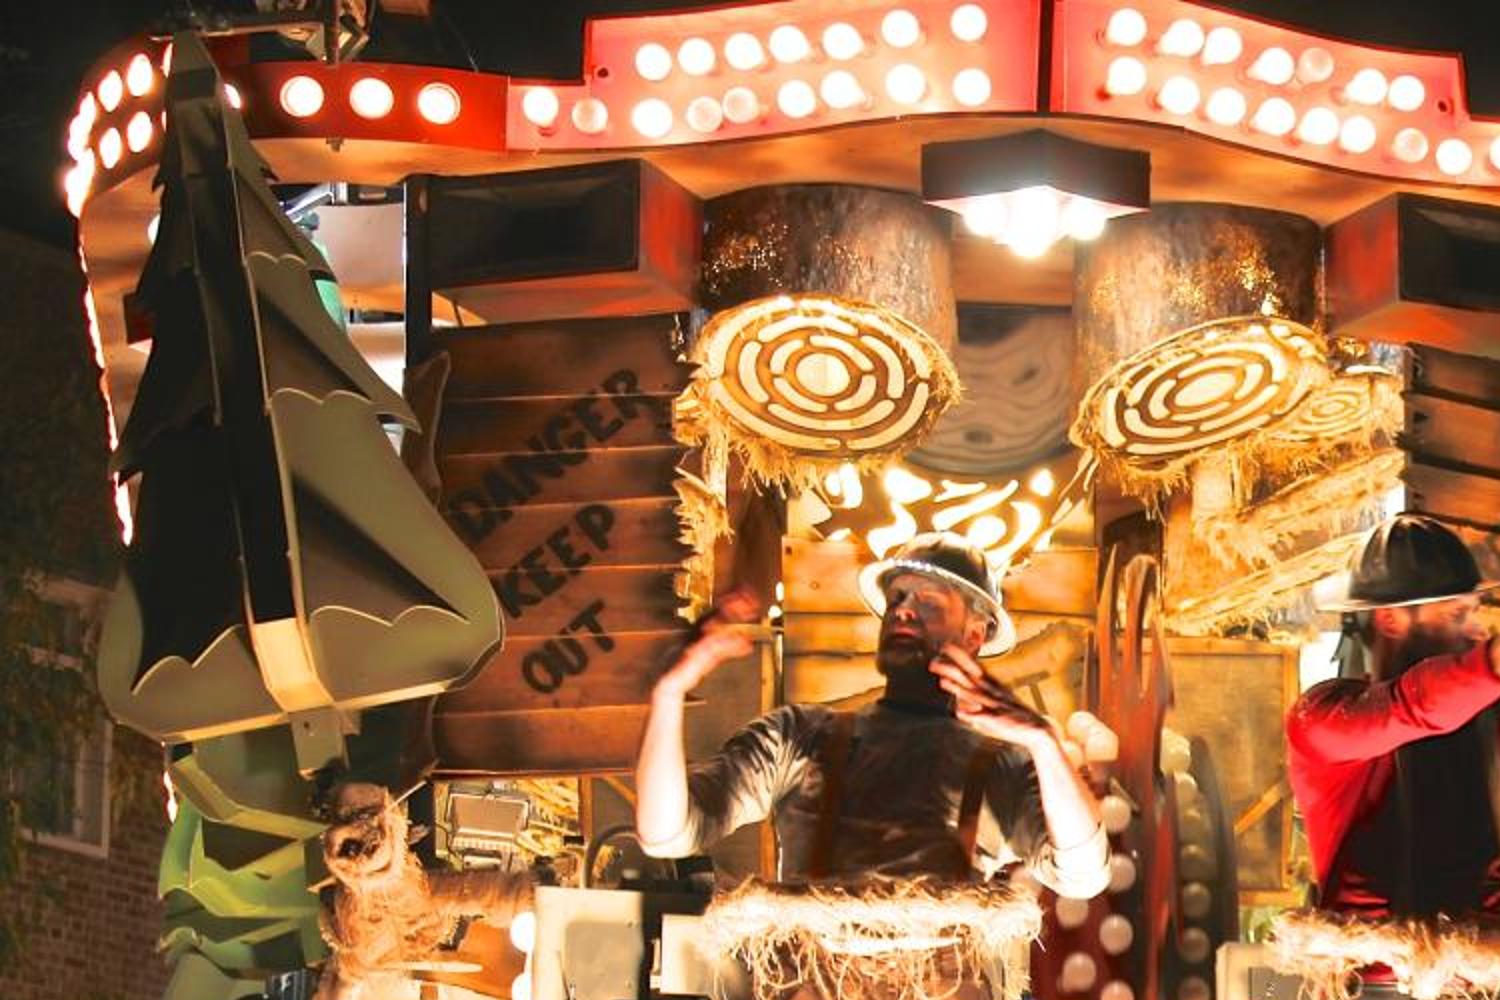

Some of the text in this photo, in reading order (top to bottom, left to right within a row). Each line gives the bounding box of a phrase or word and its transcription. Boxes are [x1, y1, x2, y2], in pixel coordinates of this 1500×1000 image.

[450, 369, 654, 543] DANGER
[501, 503, 616, 619] KEEP
[521, 601, 616, 694] OUT
